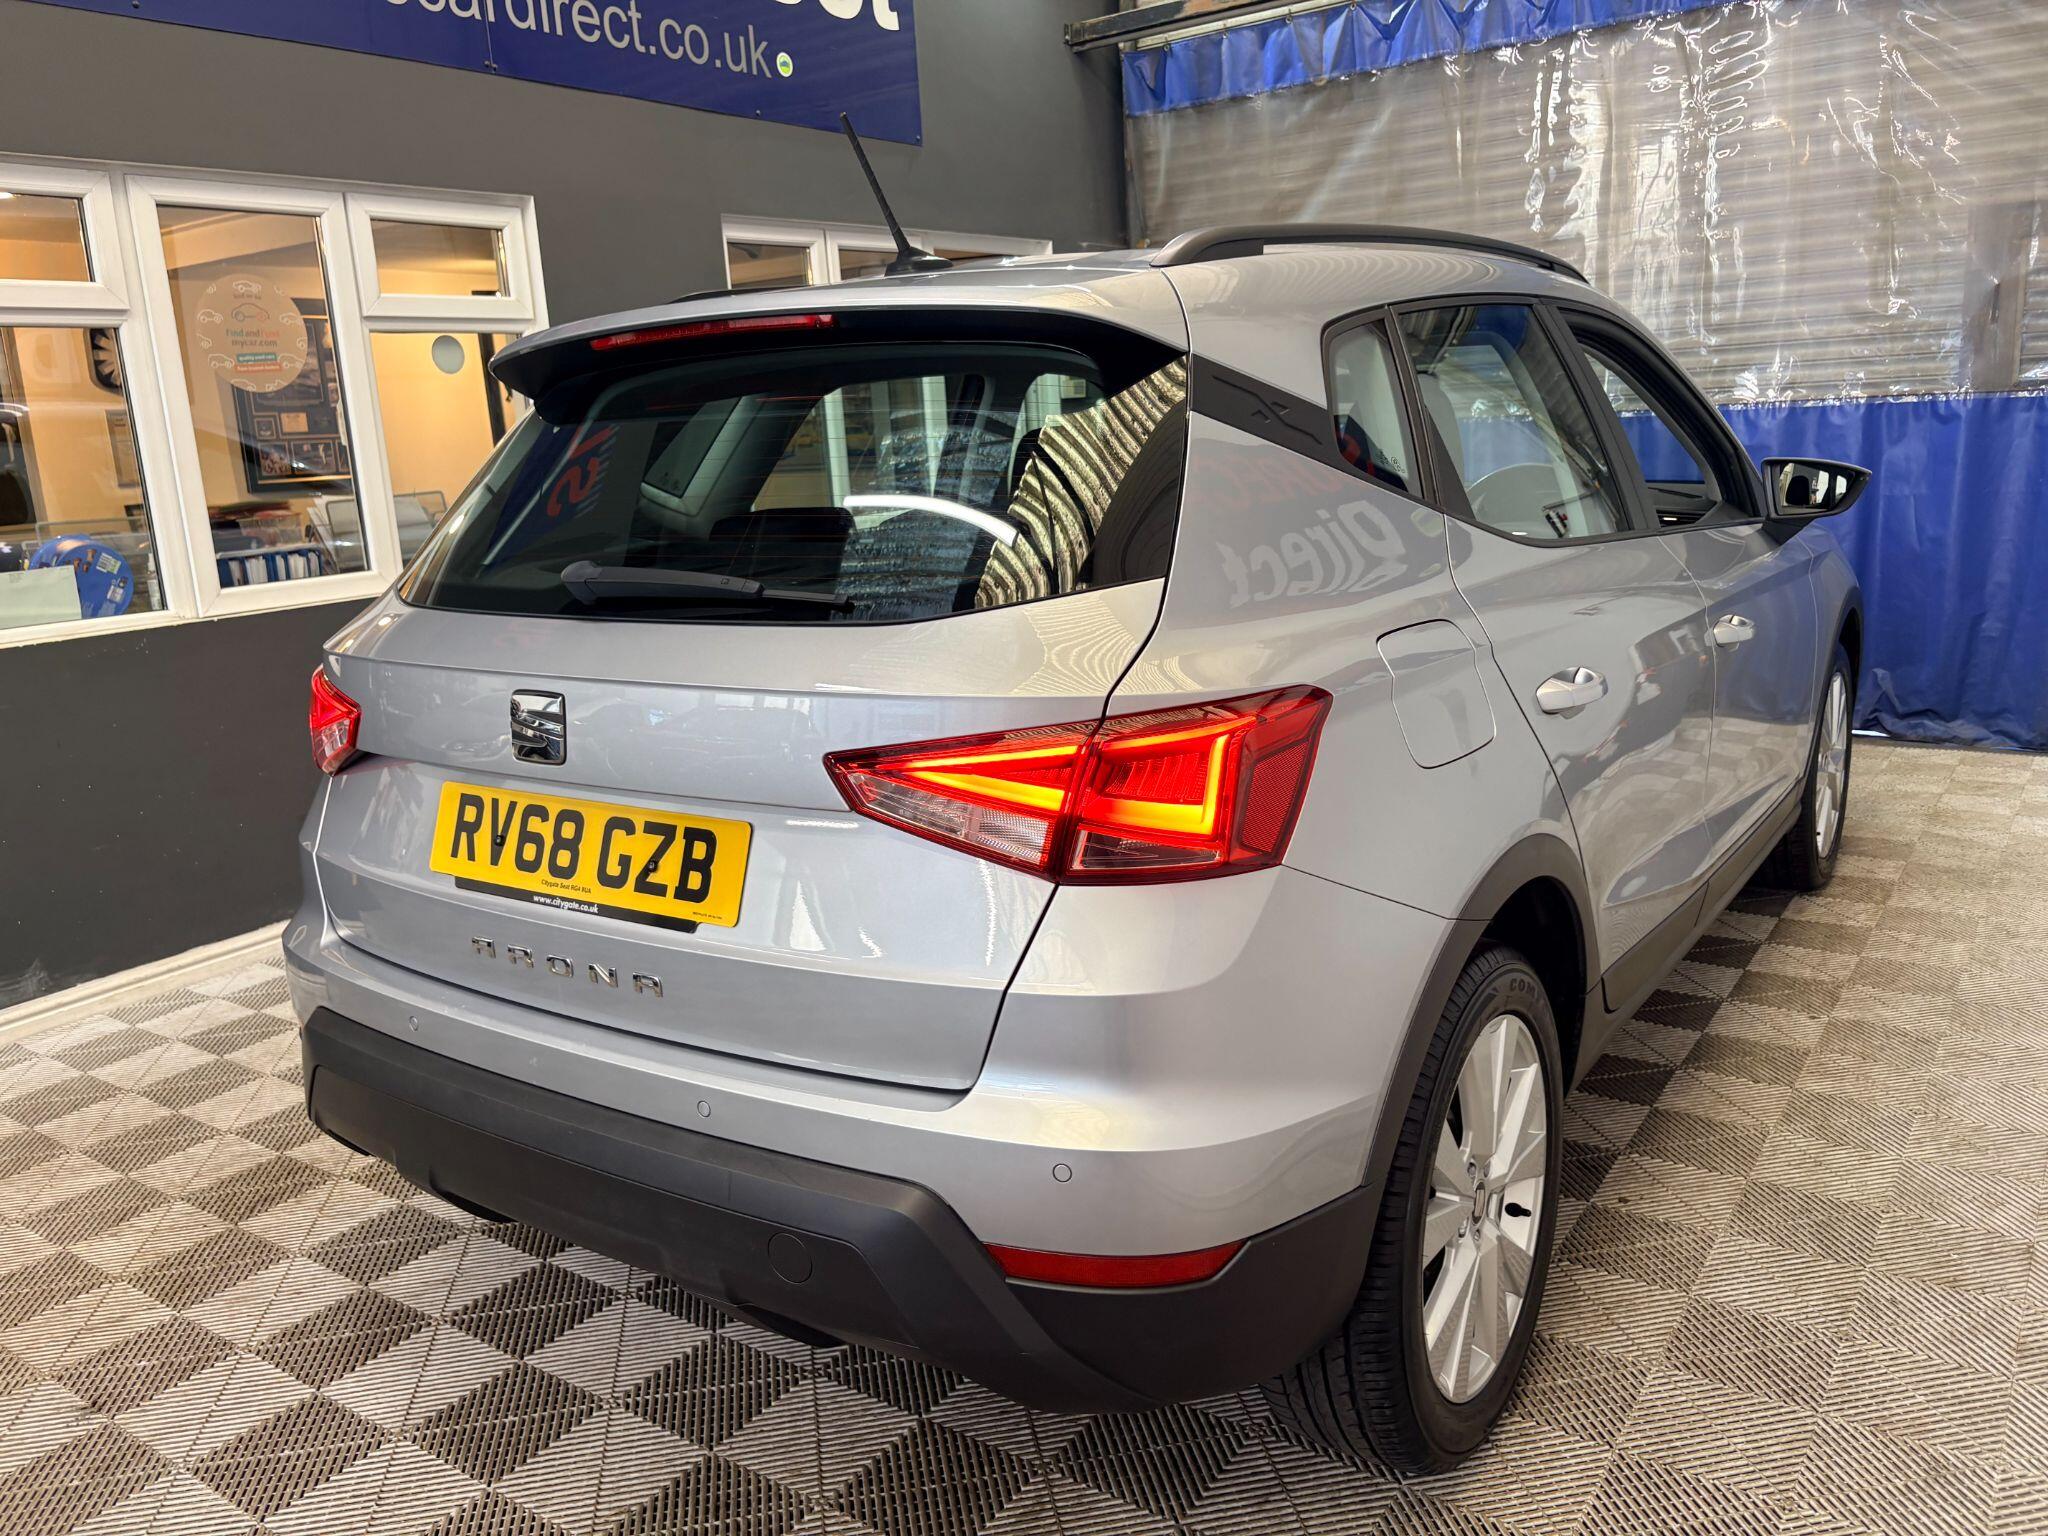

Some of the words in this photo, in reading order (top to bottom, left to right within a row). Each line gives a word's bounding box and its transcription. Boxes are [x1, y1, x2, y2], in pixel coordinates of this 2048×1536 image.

[451, 793, 585, 880] RV68
[597, 816, 717, 904] GZB
[533, 894, 599, 914] www.citygate.co.uk
[471, 936, 664, 998] ARONA
